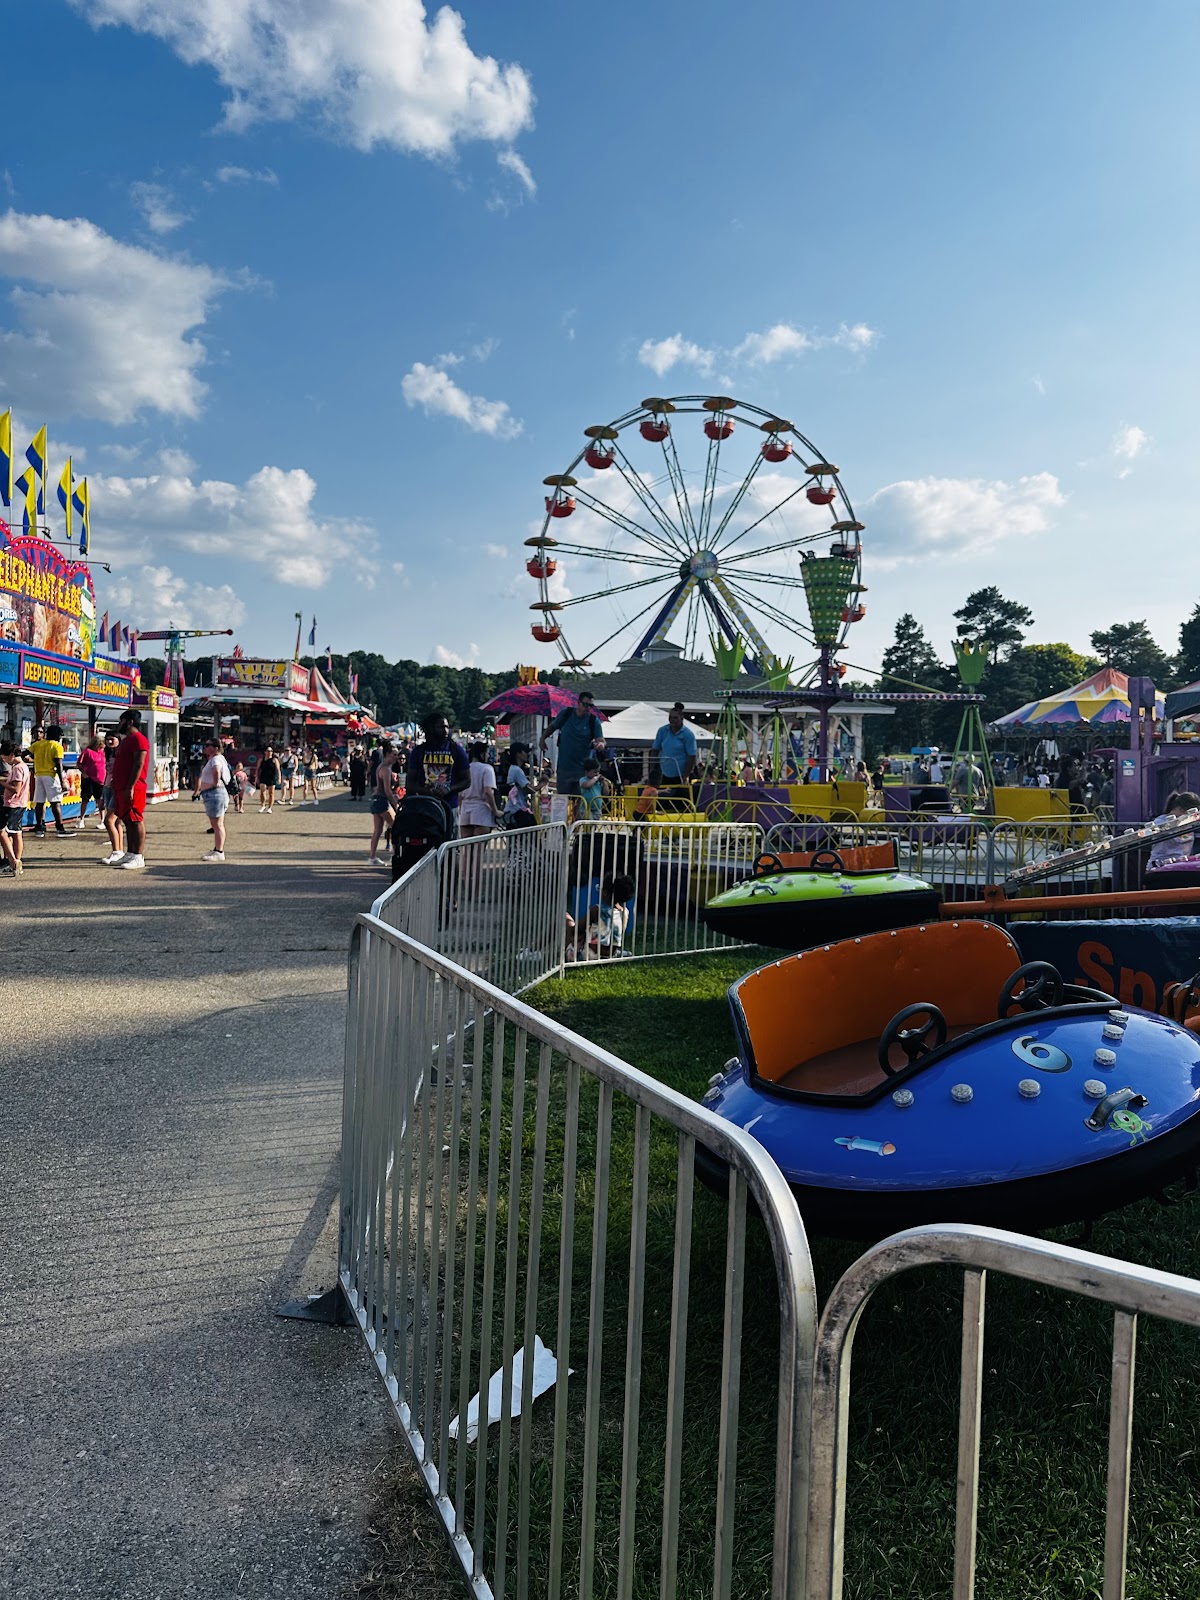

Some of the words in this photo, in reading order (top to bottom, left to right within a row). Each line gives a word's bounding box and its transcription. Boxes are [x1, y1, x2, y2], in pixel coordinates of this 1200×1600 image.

[0, 549, 56, 605] ELEPHANT
[24, 661, 42, 683] DEEP
[42, 665, 61, 686] FRIED
[61, 669, 81, 690] OREOS
[241, 663, 277, 674] FILL
[264, 674, 279, 684] UP
[99, 678, 129, 699] LEMONADE
[423, 753, 455, 766] LAKERS
